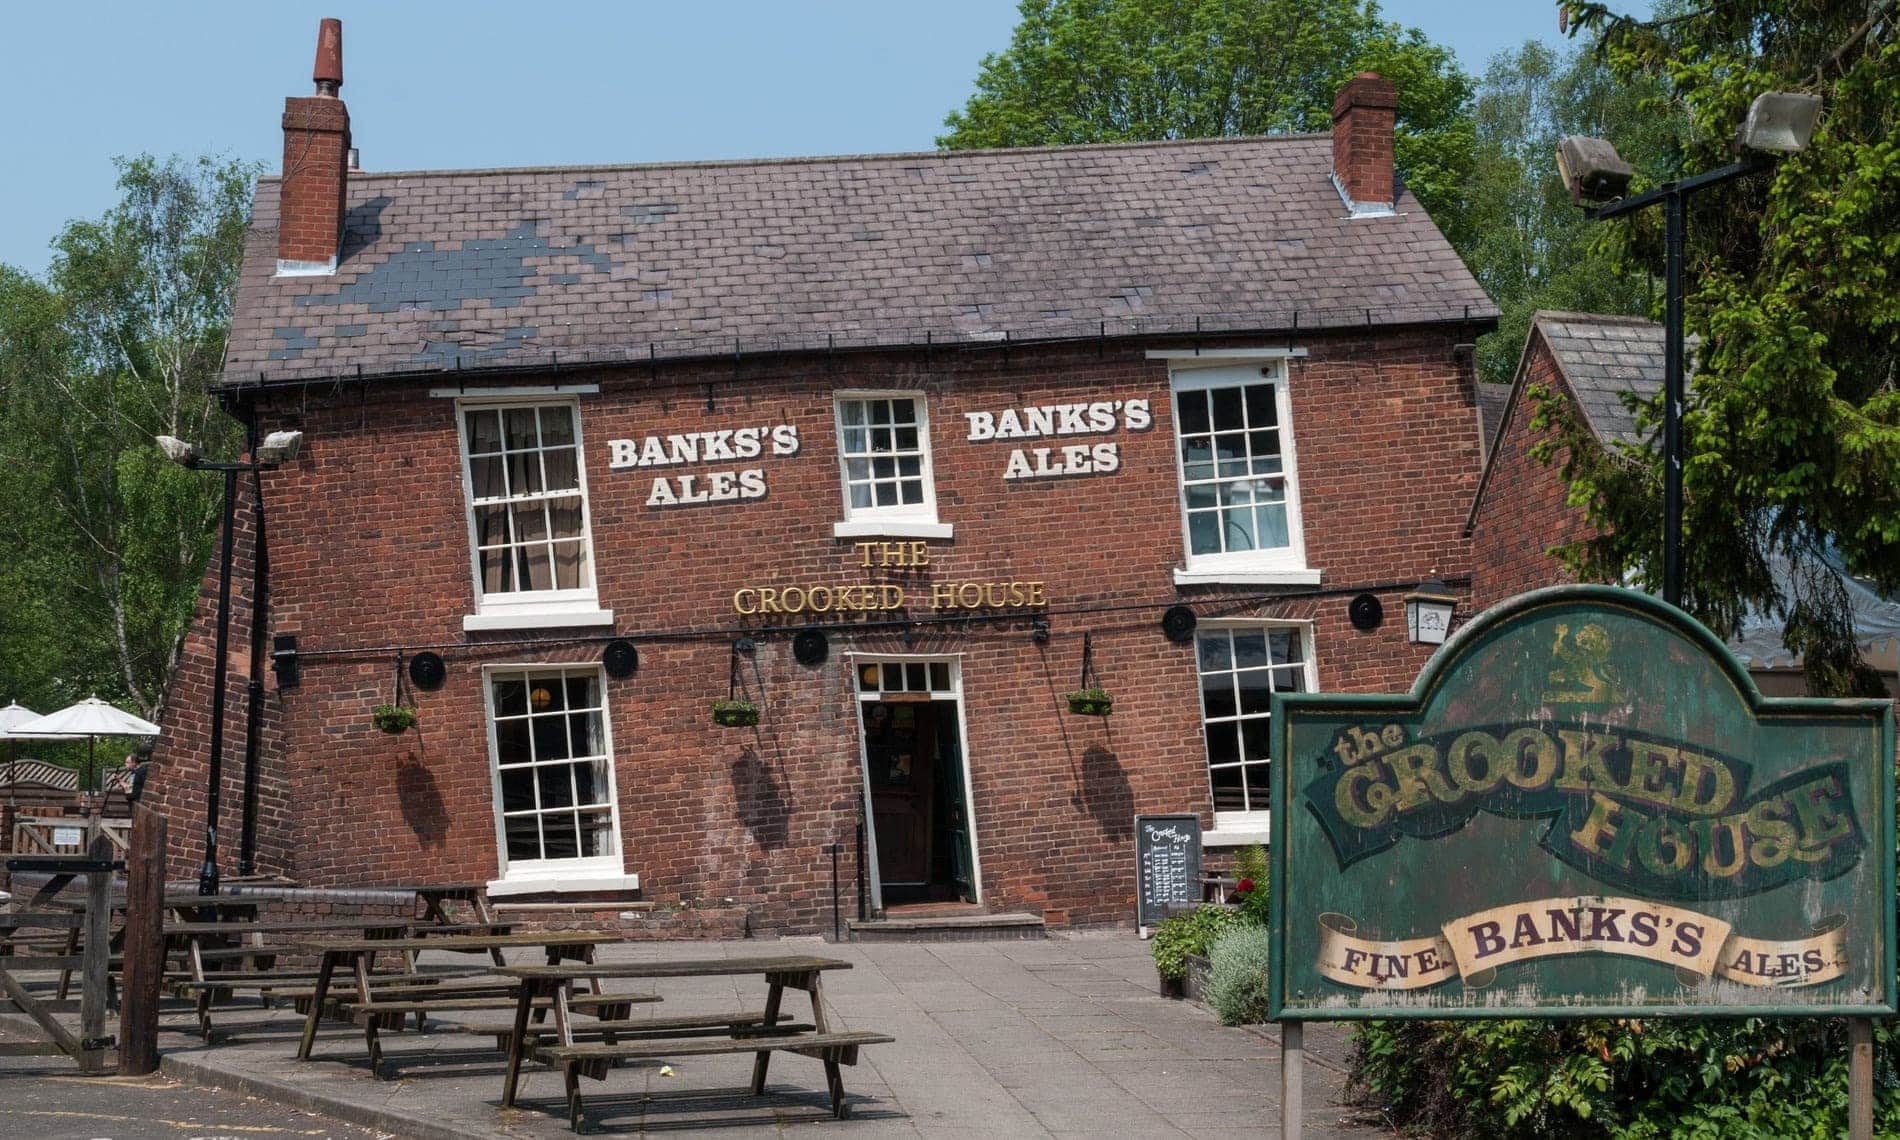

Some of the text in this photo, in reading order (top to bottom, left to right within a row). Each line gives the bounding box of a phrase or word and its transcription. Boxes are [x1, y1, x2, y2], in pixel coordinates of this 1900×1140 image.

[965, 399, 1152, 441] BANKS'S
[608, 425, 799, 468] BANKS'S
[1003, 443, 1119, 479] ALES
[645, 469, 767, 506] ALES
[855, 541, 930, 567] THE
[733, 581, 1047, 614] CROOKED HOUSE
[1334, 723, 1403, 766] the
[1335, 727, 1735, 827] CROOKED
[1571, 775, 1852, 877] HOUSE
[1340, 907, 1824, 978] FINE BANKS'S ALES
